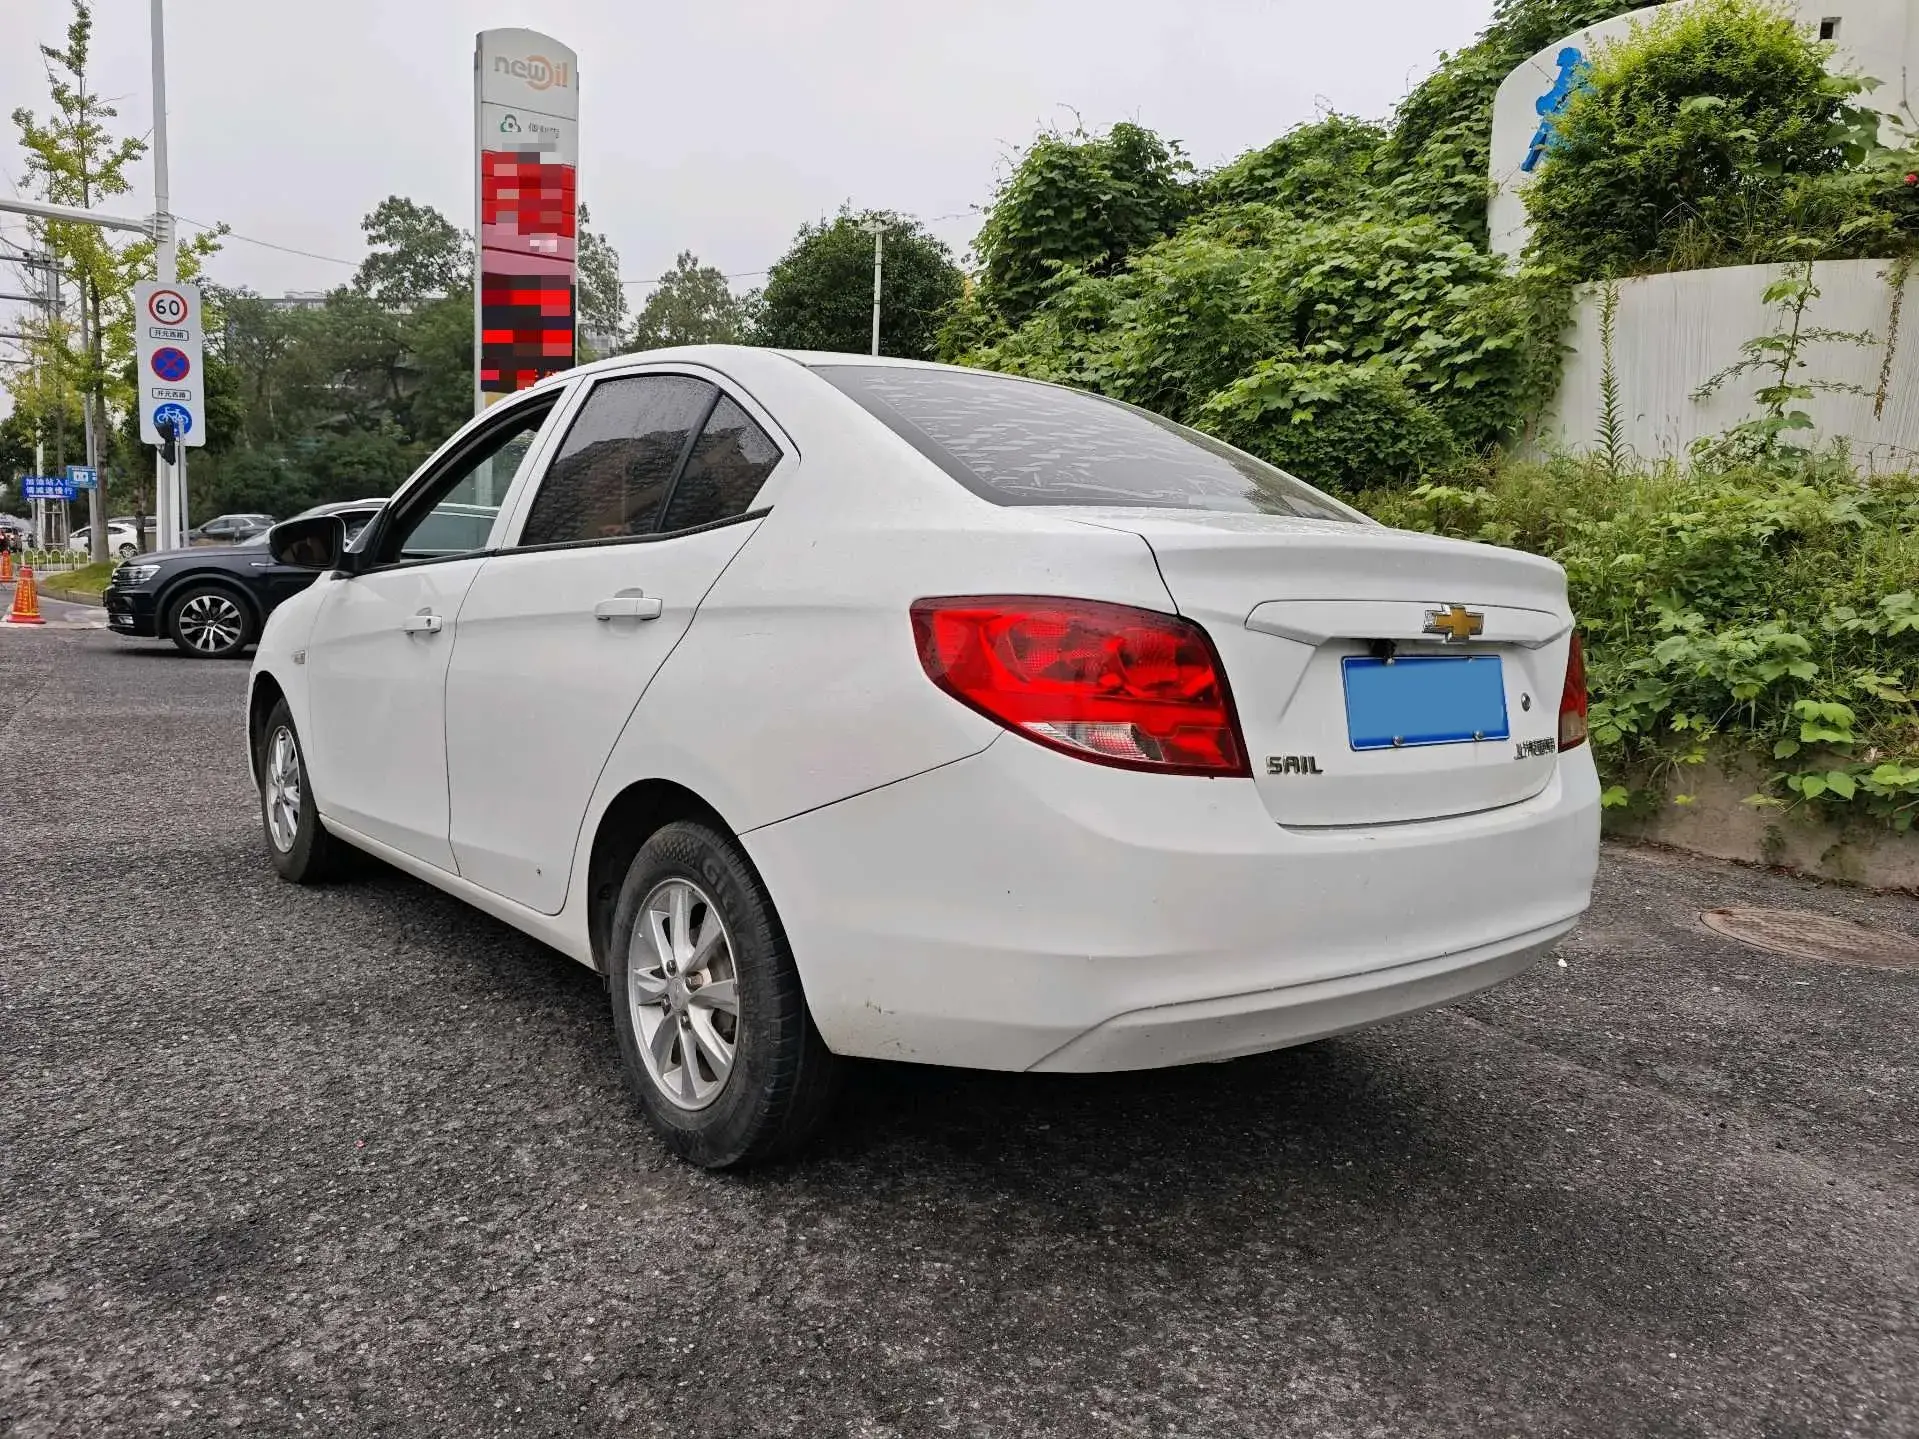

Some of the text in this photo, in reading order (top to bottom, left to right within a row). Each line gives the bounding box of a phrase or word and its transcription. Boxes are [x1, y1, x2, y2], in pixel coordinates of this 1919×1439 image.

[156, 299, 180, 316] 60
[153, 329, 184, 339] 开元西路
[25, 478, 70, 486] 加油站入
[1266, 755, 1324, 775] SAIL
